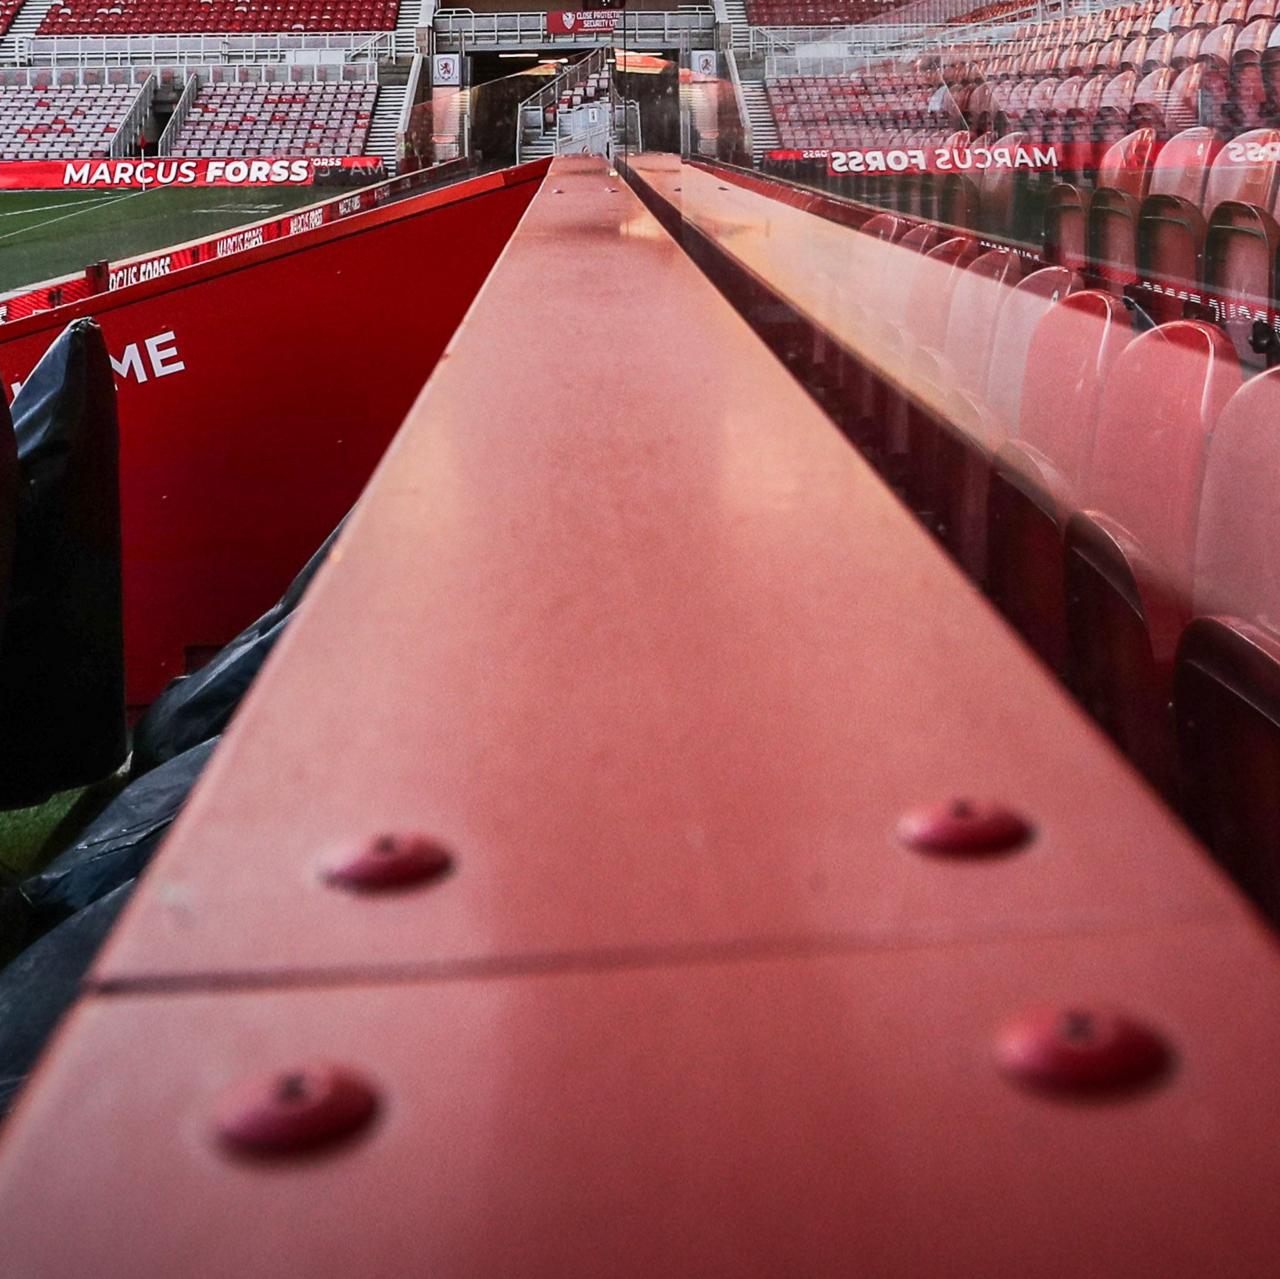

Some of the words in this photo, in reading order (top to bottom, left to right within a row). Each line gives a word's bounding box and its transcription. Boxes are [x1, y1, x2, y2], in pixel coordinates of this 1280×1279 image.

[576, 12, 593, 20] CLOSE
[583, 19, 608, 28] SECURITY
[63, 162, 197, 185] MARCUS
[206, 160, 309, 183] FORSS
